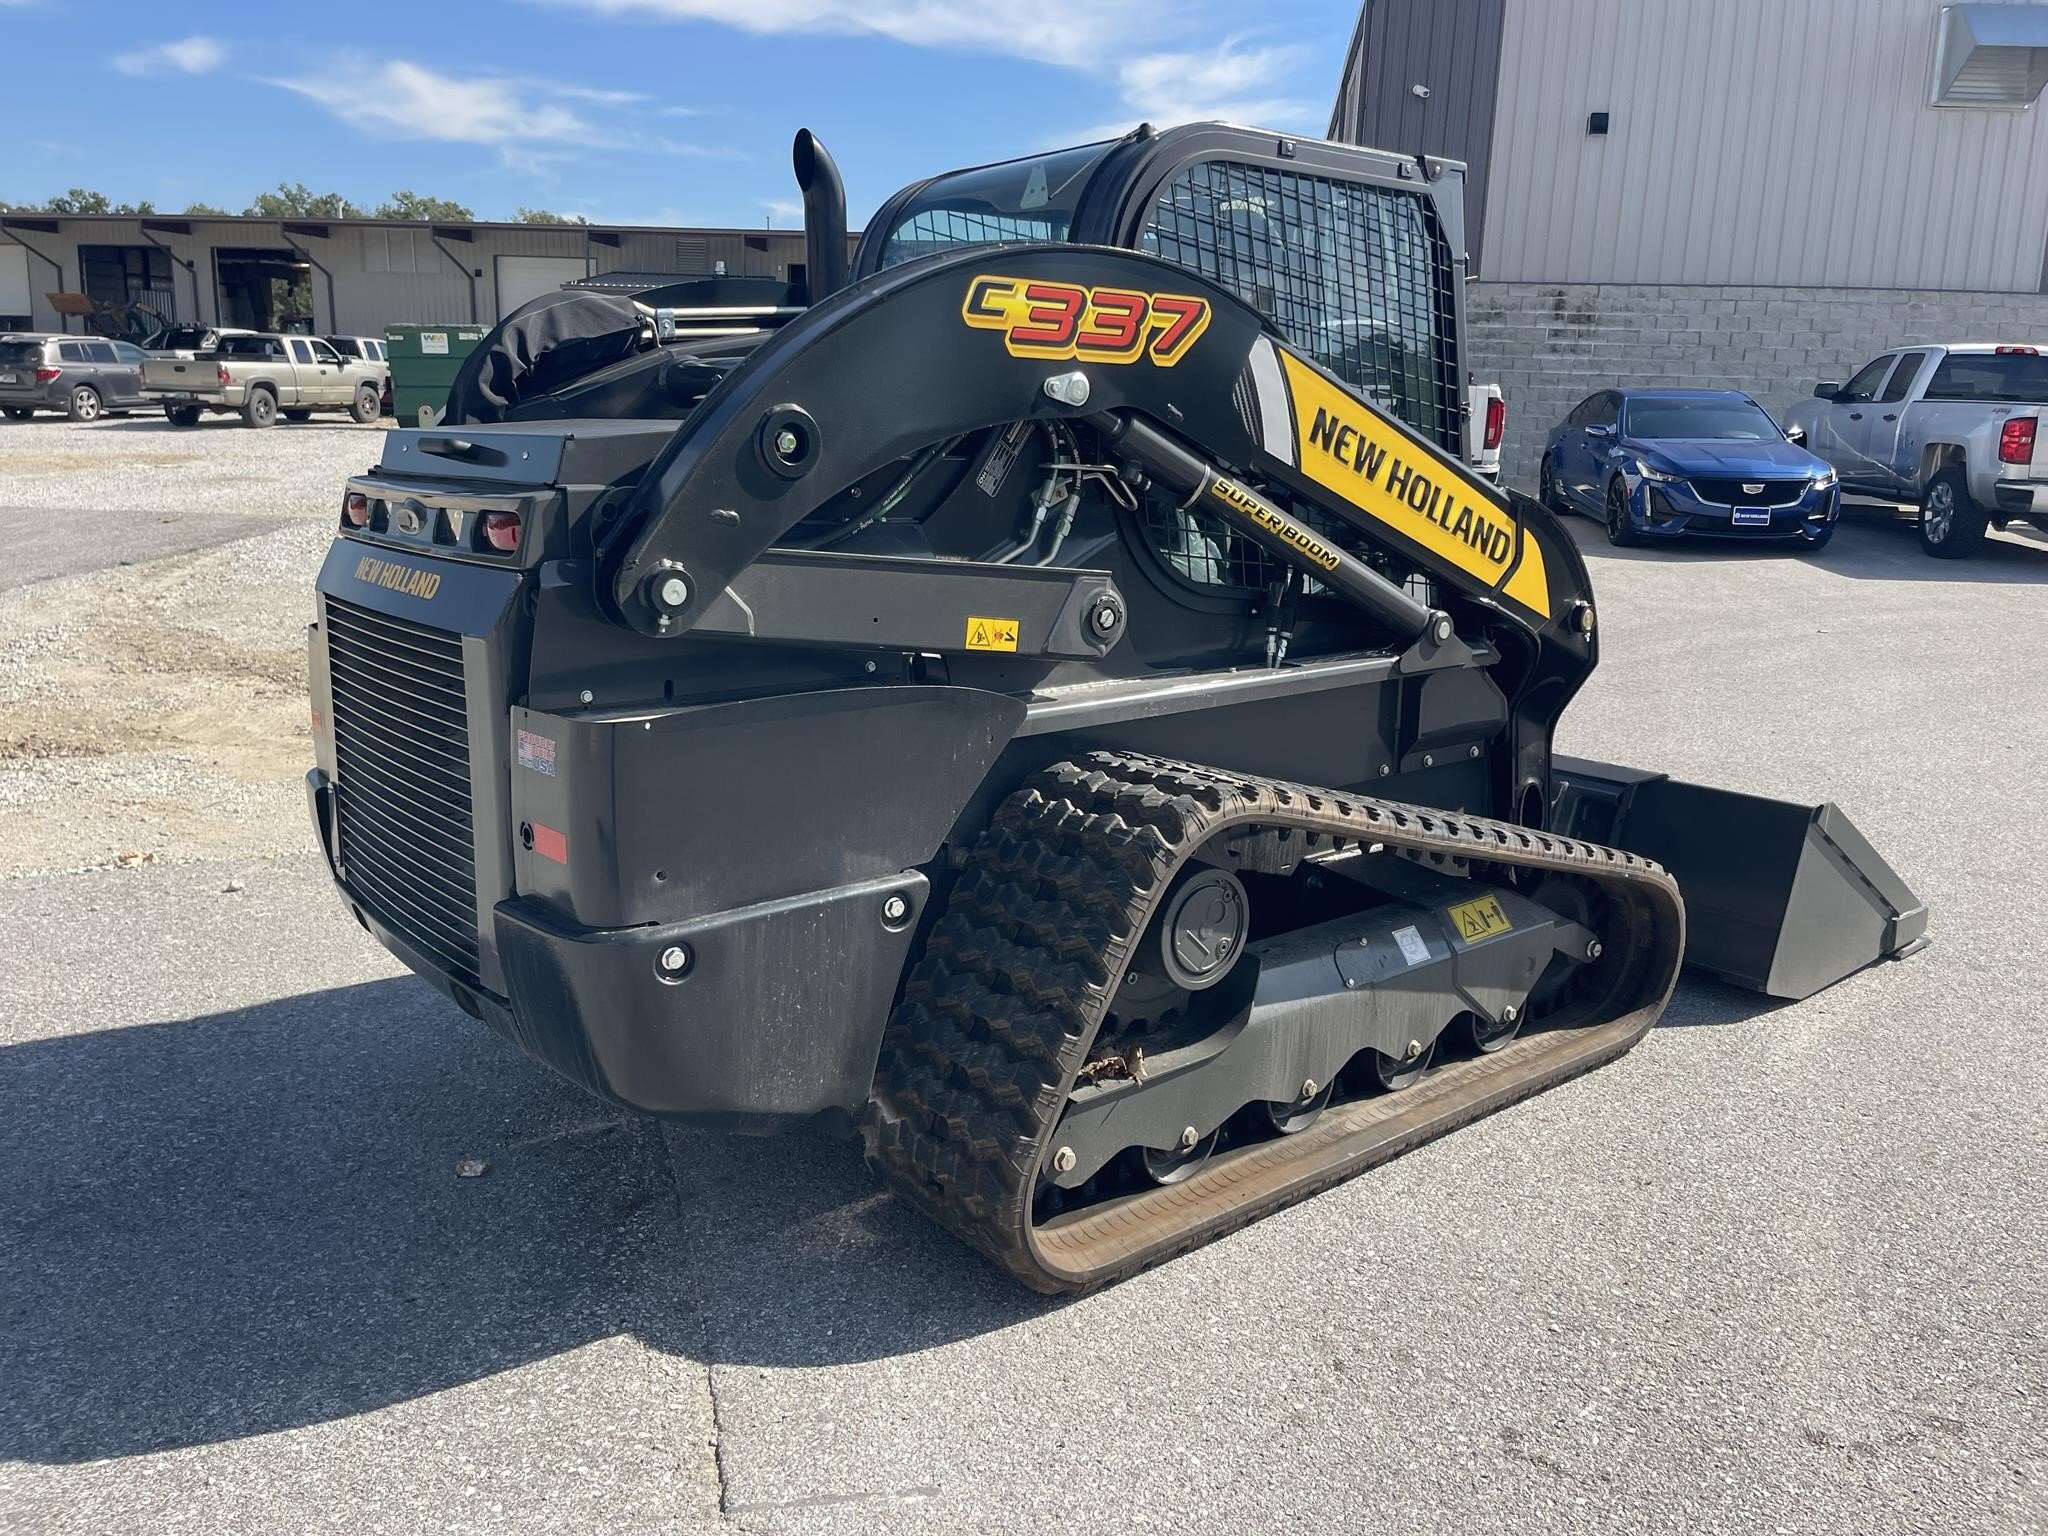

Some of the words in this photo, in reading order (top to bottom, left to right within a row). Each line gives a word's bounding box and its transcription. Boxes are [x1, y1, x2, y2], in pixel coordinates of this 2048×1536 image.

[963, 275, 1211, 367] C337
[1212, 478, 1284, 534] SUPER
[1280, 523, 1341, 571] BOOM
[1309, 406, 1388, 483] NEW
[1384, 457, 1511, 565] HOLLAND
[354, 556, 385, 584] NEW
[377, 562, 441, 600] HOLLAND
[533, 757, 556, 777] USA
